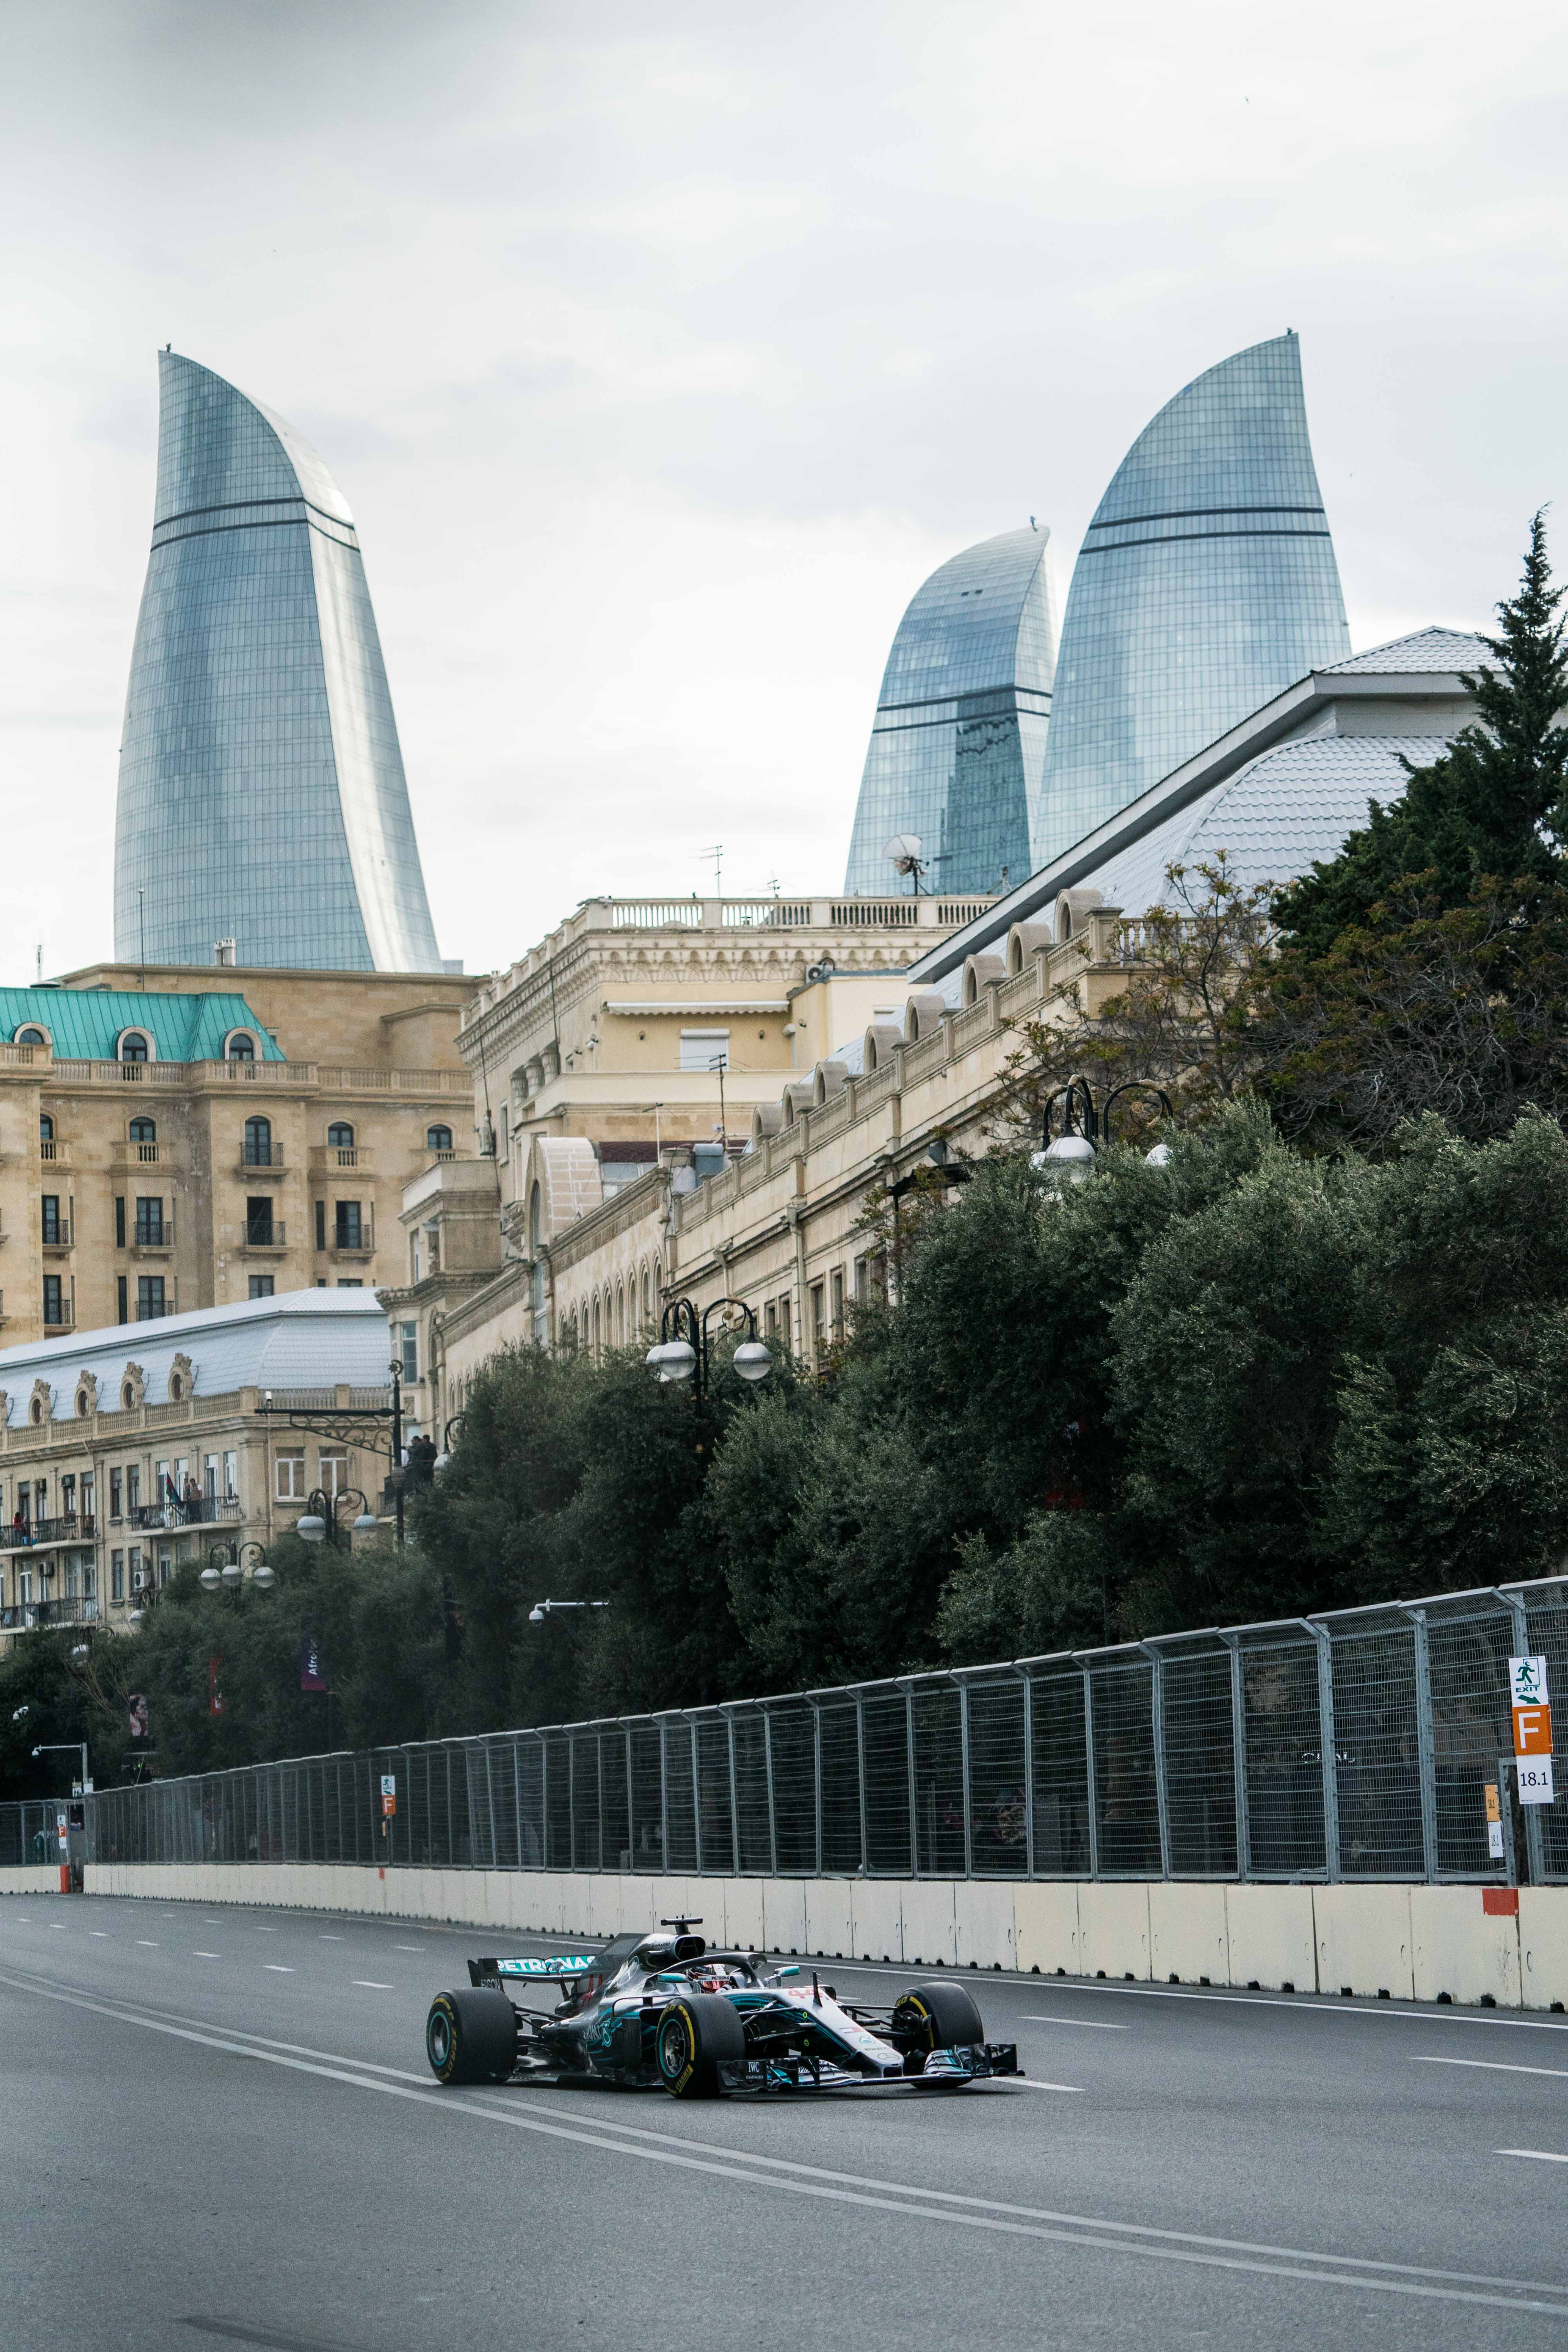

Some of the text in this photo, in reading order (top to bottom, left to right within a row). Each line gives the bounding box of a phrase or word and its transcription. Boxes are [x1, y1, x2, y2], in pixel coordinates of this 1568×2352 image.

[1518, 1712, 1541, 1749] F
[1520, 1771, 1548, 1786] 18.1
[384, 1797, 393, 1813] F
[1491, 1834, 1499, 1846] 18.1
[497, 1956, 596, 1972] PETRONAS
[748, 2061, 760, 2073] IWC
